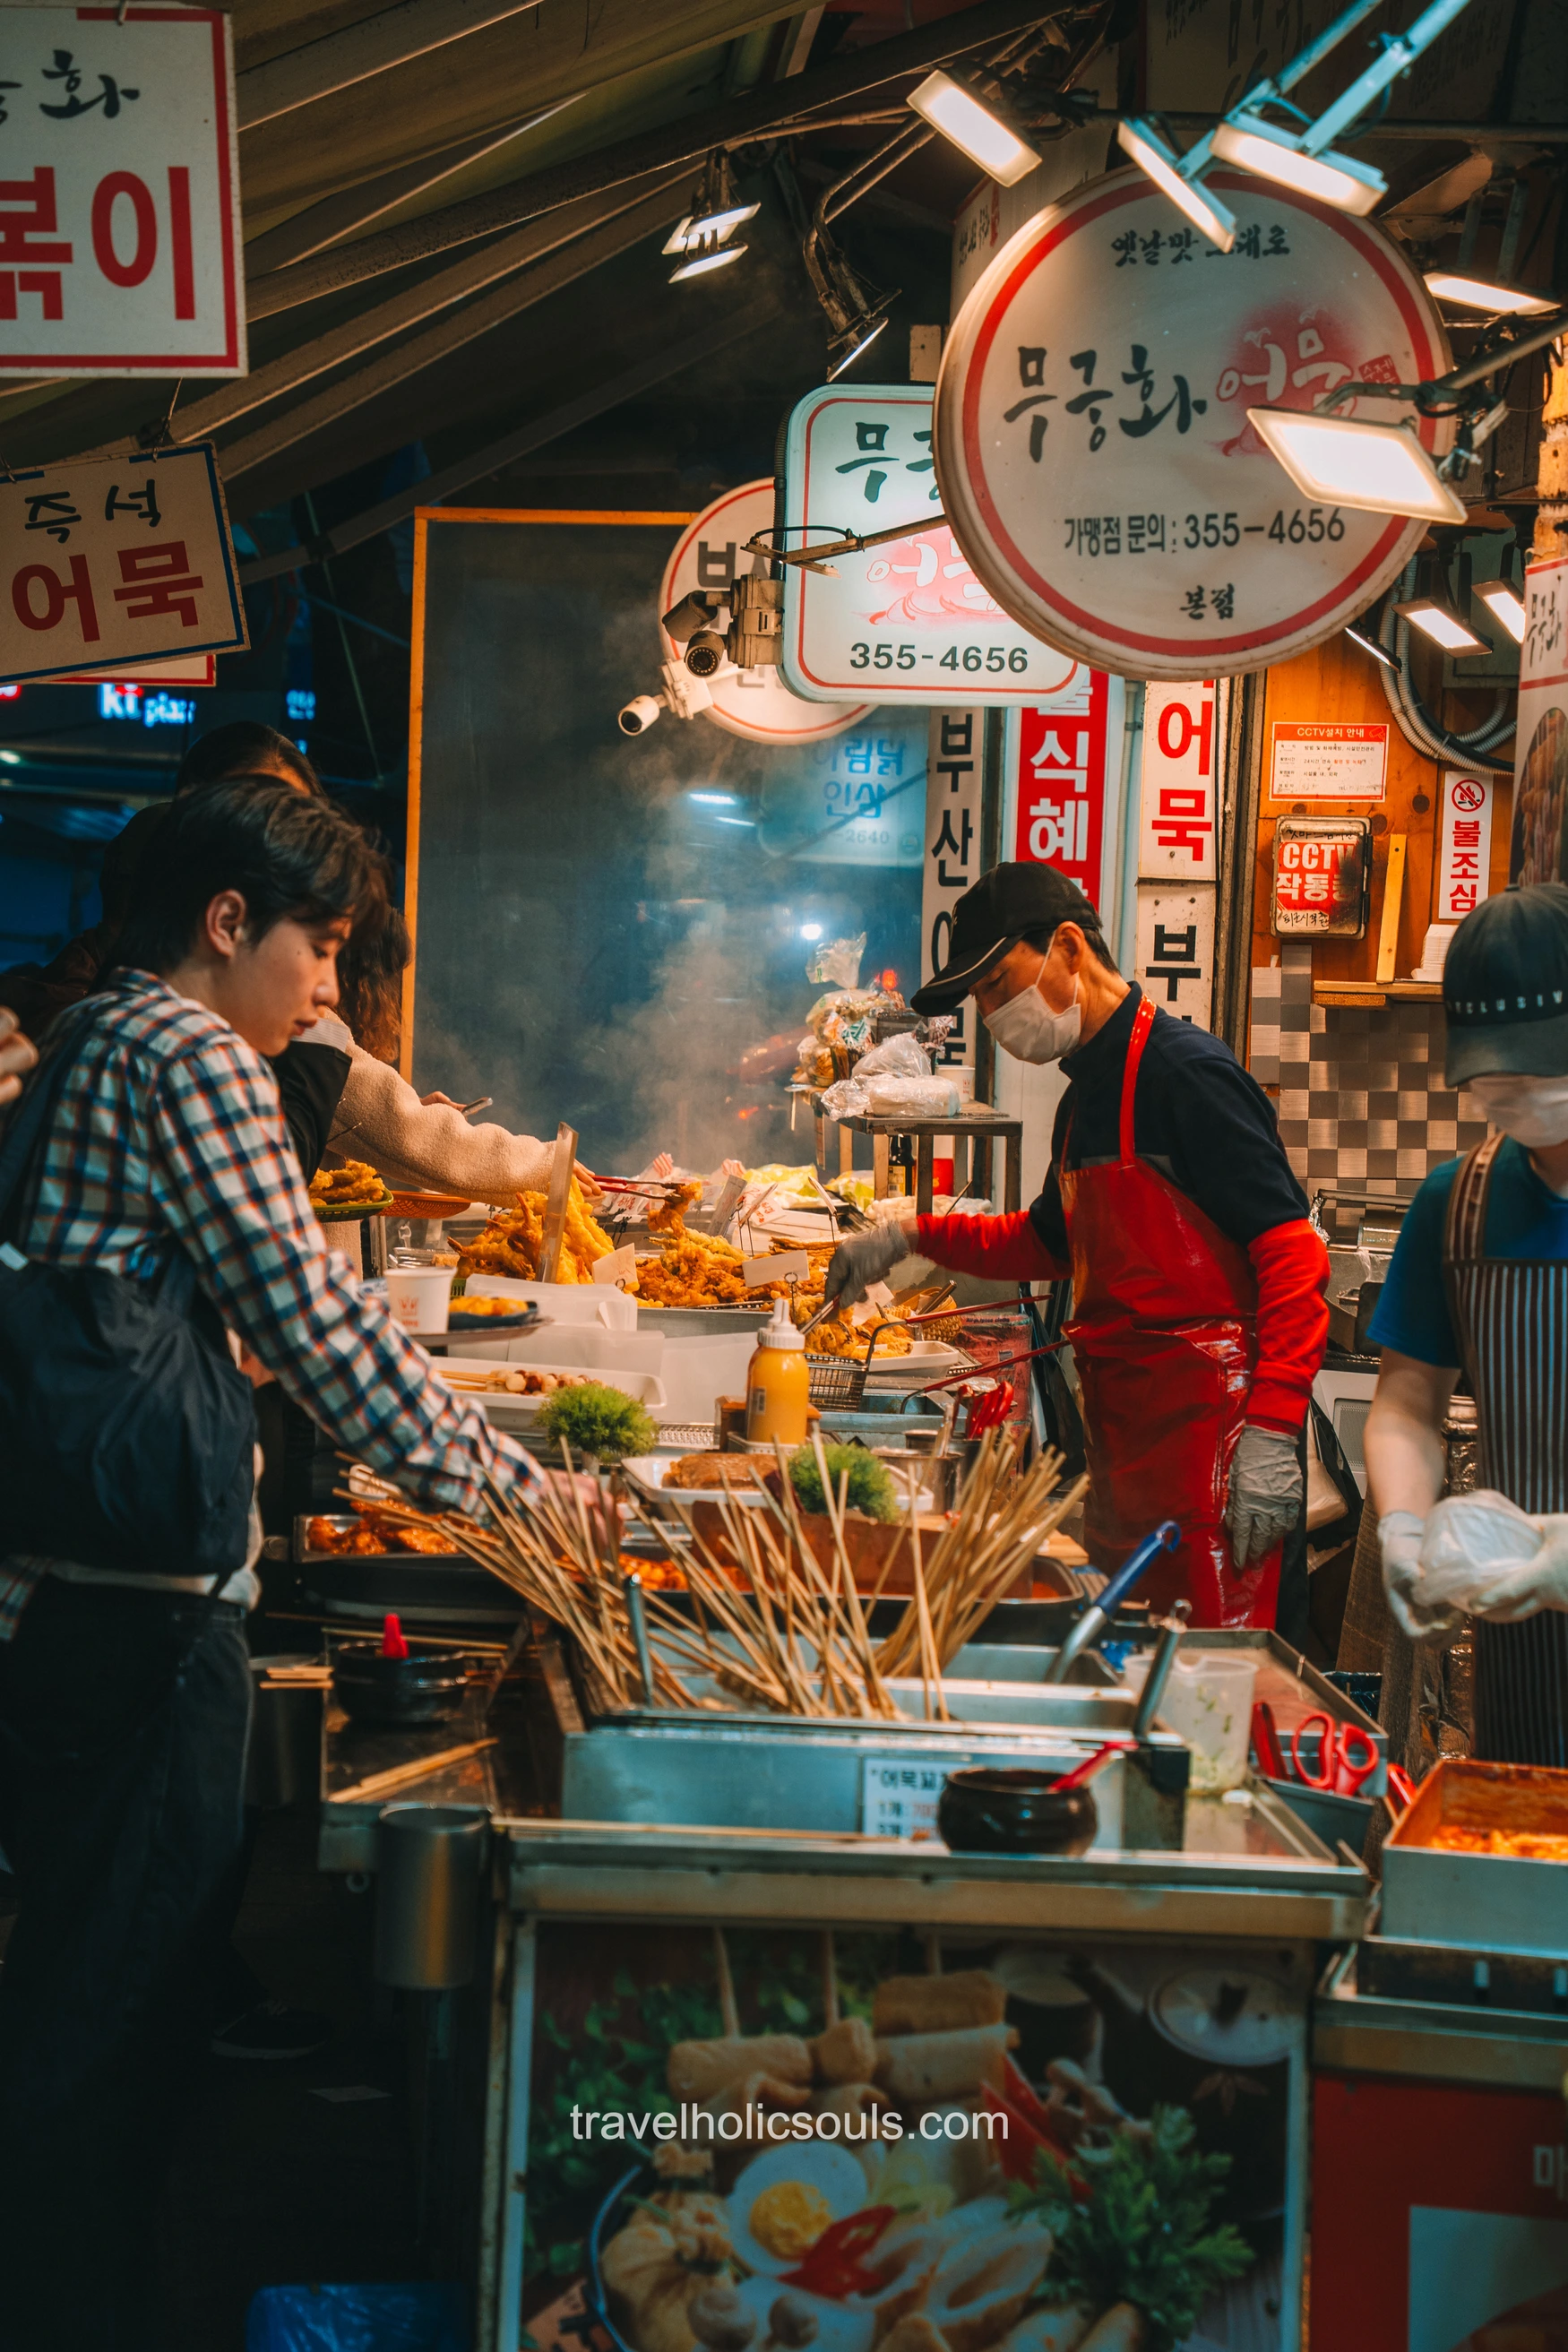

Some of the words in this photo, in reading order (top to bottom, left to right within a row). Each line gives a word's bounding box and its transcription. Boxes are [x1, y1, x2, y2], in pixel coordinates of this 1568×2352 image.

[1004, 345, 1207, 463] 무궁화
[25, 478, 161, 543] 즉석
[1064, 516, 1120, 556] 가맹점
[12, 540, 204, 642] 어묵
[850, 642, 1028, 673] 355-4656
[1297, 727, 1343, 738] CCTV설치
[1346, 728, 1365, 738] 안내
[1282, 843, 1356, 870] CCTV
[1450, 821, 1481, 912] 불조심
